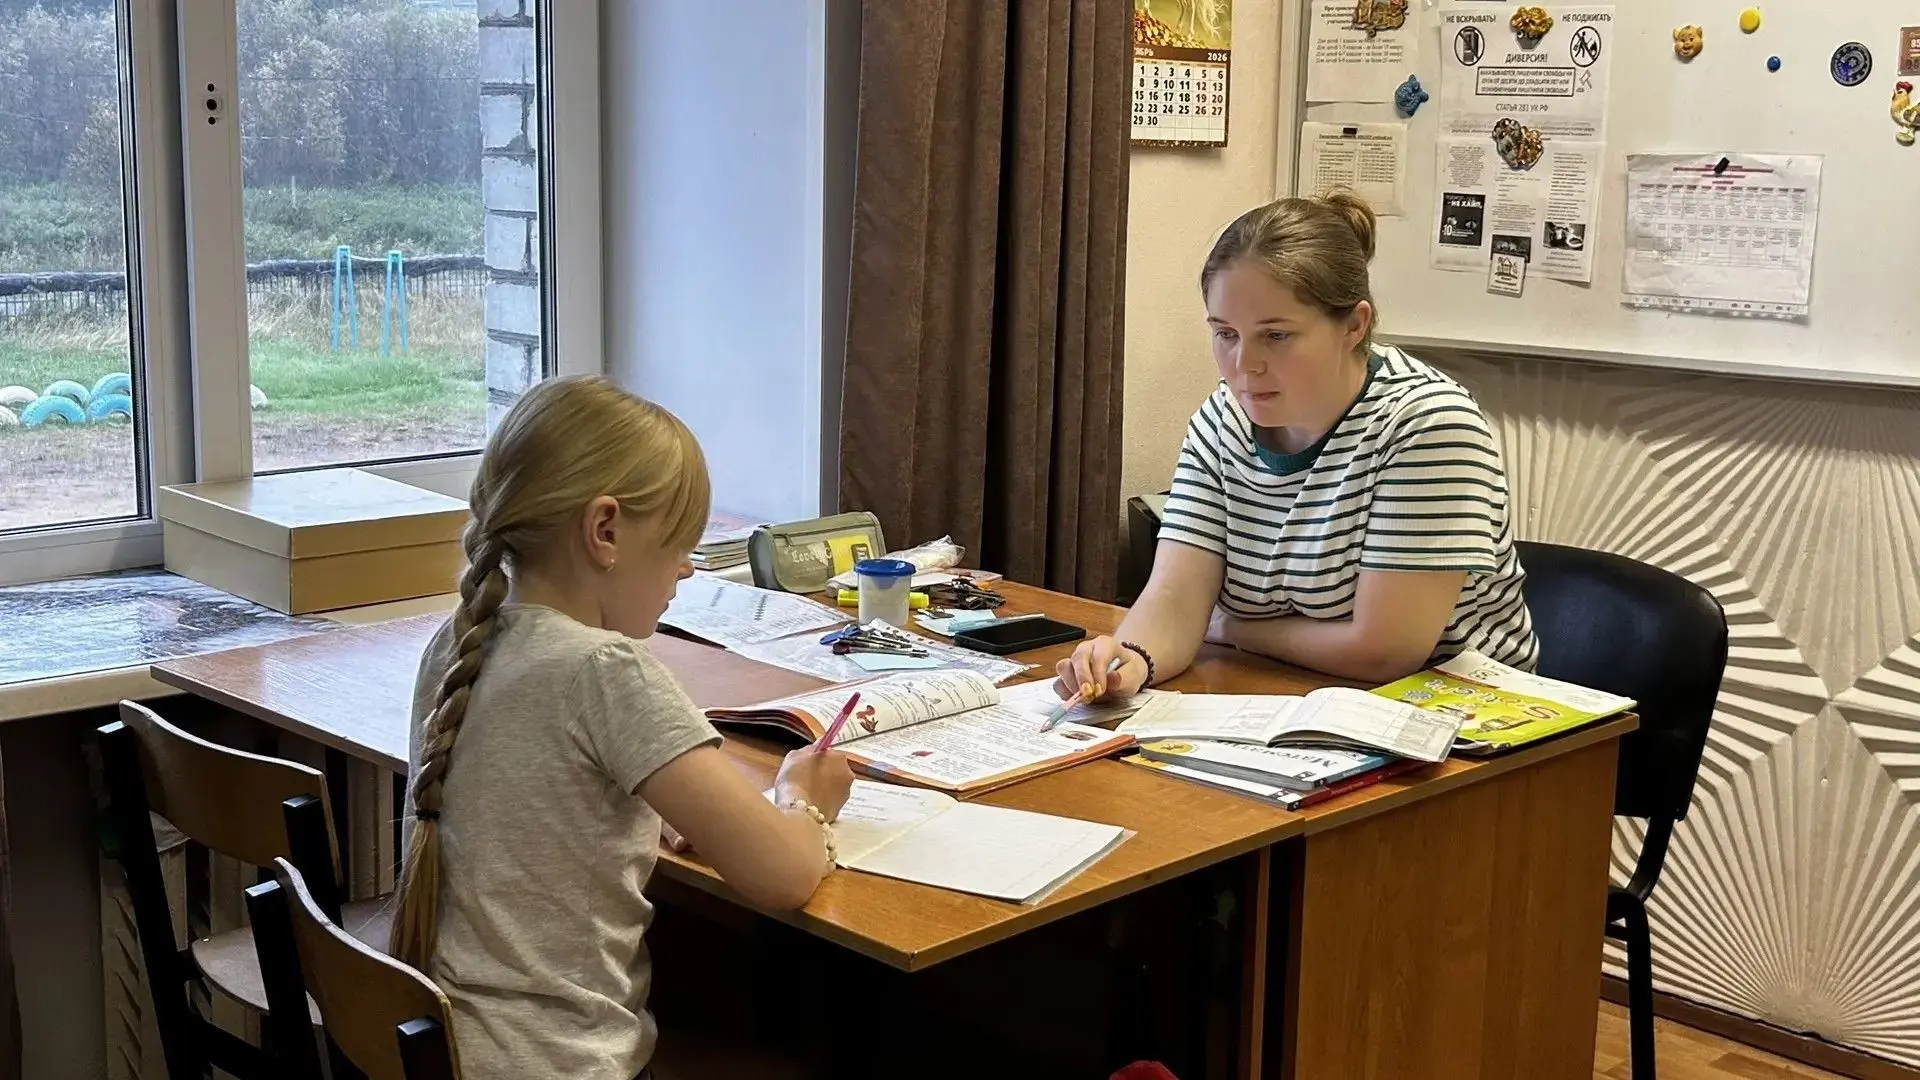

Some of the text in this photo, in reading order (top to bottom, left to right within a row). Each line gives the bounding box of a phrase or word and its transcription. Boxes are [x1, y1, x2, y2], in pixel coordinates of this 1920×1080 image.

[1446, 14, 1496, 23] НЕ ВСКРЫВАТЬ!
[1562, 13, 1571, 22] НЕ
[1207, 52, 1228, 62] 2026
[1505, 53, 1548, 64] ДИВЕРСИЯ!
[1141, 66, 1223, 79] 1 2 3 4 5 6
[1140, 78, 1223, 91] 8 9 10 11 12 13
[1135, 91, 1223, 103] 15 16 17 18 19 20
[1134, 103, 1223, 115] 22 23 24 25 26 27
[1495, 103, 1517, 111] СТАТЬЯ
[1539, 104, 1549, 112] РФ
[1133, 116, 1157, 125] 29 30
